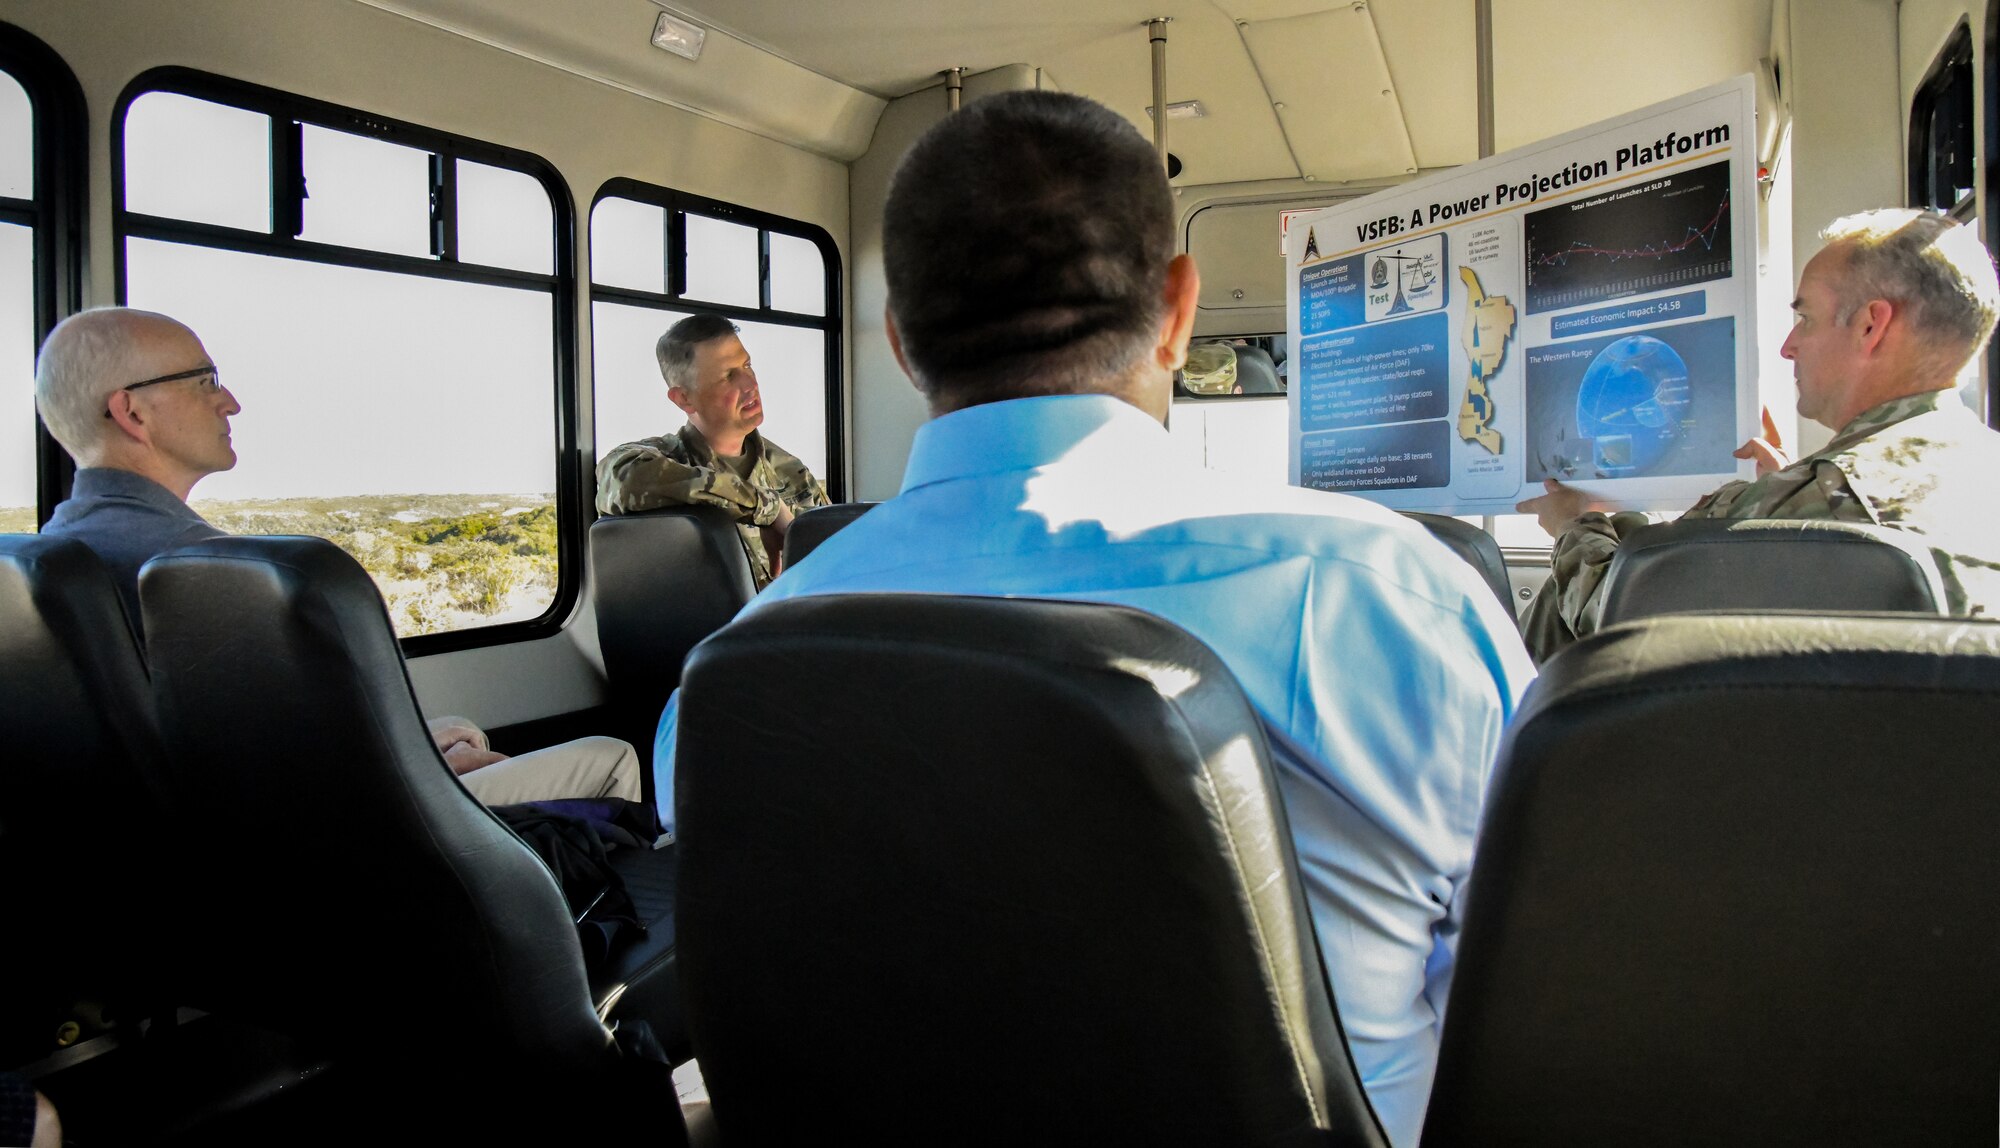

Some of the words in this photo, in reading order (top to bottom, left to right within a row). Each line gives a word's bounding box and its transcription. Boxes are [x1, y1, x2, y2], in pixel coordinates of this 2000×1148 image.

[1357, 216, 1404, 242] VSFB:
[1410, 209, 1423, 229] A
[1429, 193, 1489, 224] Power
[1496, 160, 1608, 205] Projection
[1616, 124, 1730, 172] Platform
[1571, 202, 1584, 211] Total
[1586, 197, 1607, 207] Number
[1616, 189, 1642, 200] Launches
[1651, 183, 1662, 191] SLD
[1302, 272, 1320, 281] Unique
[1321, 265, 1348, 276] Operations
[1311, 280, 1327, 289] Launch
[1328, 277, 1338, 285] and
[1338, 283, 1356, 294] Brigade
[1369, 292, 1389, 305] Test
[1407, 290, 1432, 301] Spaceport
[1554, 317, 1589, 330] Estimated
[1591, 311, 1626, 324] Economic
[1627, 306, 1656, 318] Impact:
[1658, 300, 1681, 313] $4.5B
[1342, 357, 1355, 365] miles
[1356, 355, 1361, 363] of
[1361, 350, 1391, 363] high-power
[1408, 346, 1420, 355] only
[1530, 356, 1542, 364] The
[1543, 352, 1570, 363] Western
[1571, 349, 1593, 361] Range
[1334, 366, 1364, 377] Department
[1380, 361, 1394, 369] Force
[1395, 357, 1410, 368] (DAF)
[1382, 370, 1410, 381] state/local
[1410, 368, 1425, 377] reqts
[1394, 393, 1410, 402] pump
[1410, 390, 1433, 399] stations
[1374, 406, 1388, 414] miles
[1321, 458, 1345, 467] personnel
[1346, 457, 1366, 465] average
[1367, 454, 1379, 463] daily
[1403, 452, 1410, 460] 38
[1411, 452, 1432, 460] tenants
[1323, 467, 1345, 476] wildland
[1345, 467, 1353, 475] fire
[1373, 466, 1385, 474] DoD
[1319, 479, 1335, 488] largest
[1336, 479, 1356, 487] Security
[1356, 478, 1373, 486] Forces
[1373, 476, 1399, 486] Squadron
[1399, 475, 1405, 483] in
[1406, 474, 1418, 483] DAF
